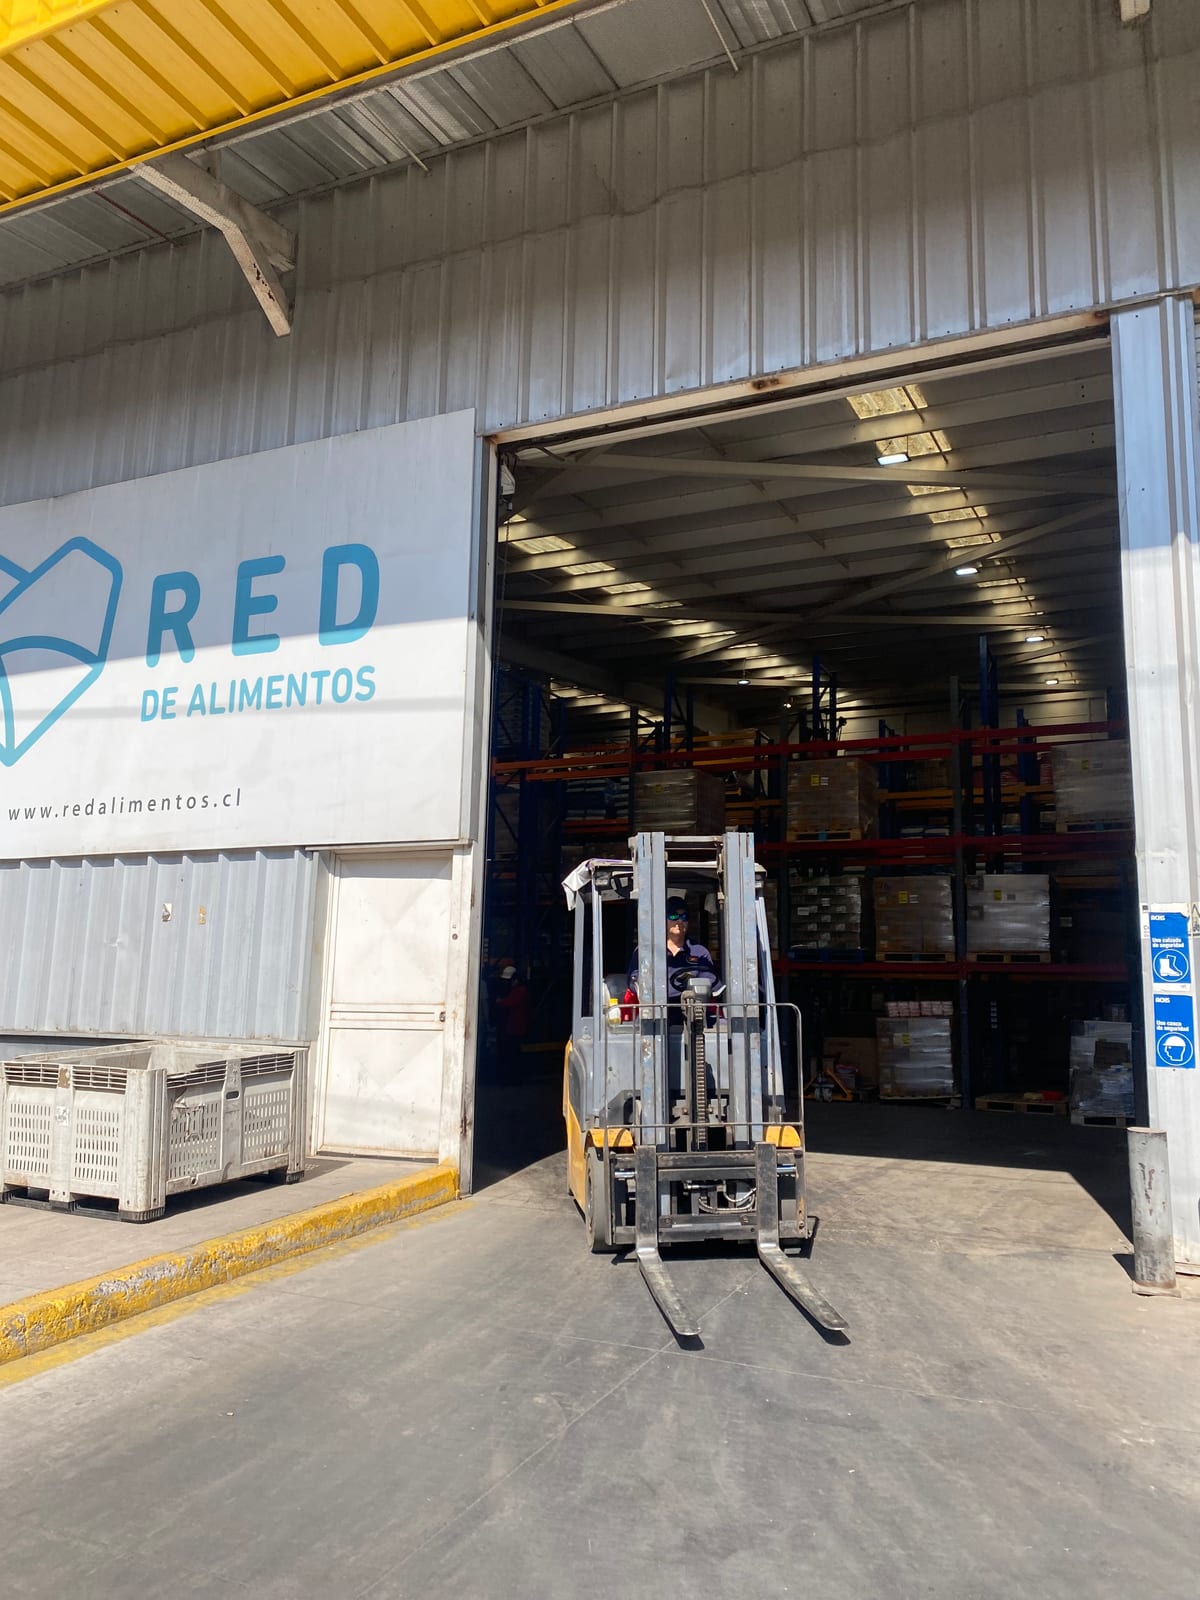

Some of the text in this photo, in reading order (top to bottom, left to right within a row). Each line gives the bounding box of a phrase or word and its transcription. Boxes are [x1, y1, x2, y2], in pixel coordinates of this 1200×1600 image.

[146, 543, 381, 668] RED
[140, 665, 376, 722] DE ALIMENTOS
[8, 788, 241, 820] www.redalimentos.cl
